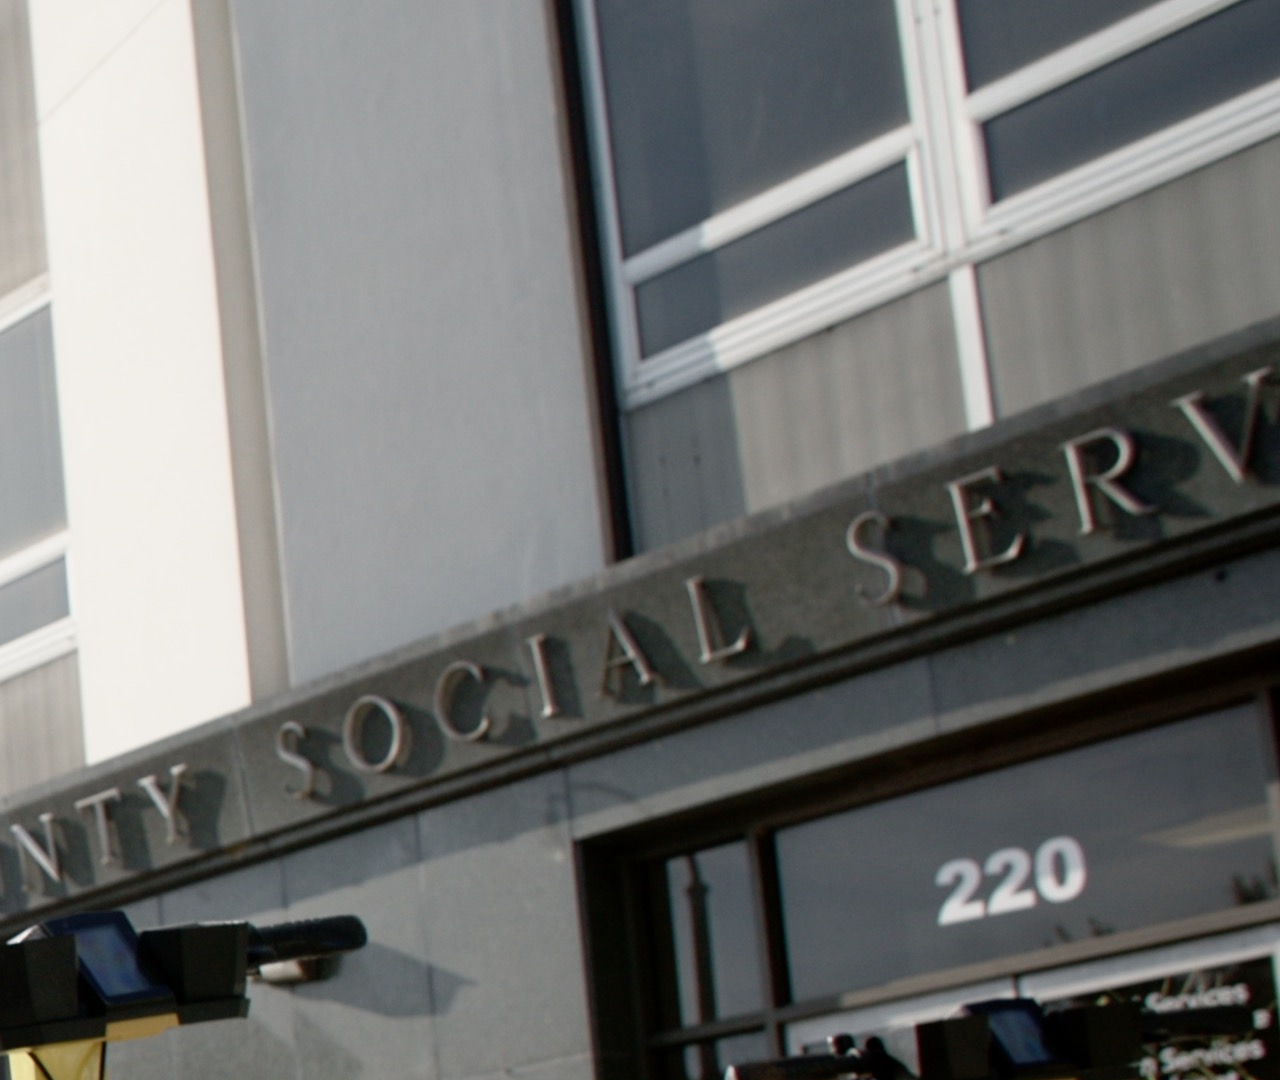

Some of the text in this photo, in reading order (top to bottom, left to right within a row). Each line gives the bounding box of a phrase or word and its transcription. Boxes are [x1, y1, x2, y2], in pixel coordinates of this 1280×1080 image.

[275, 574, 750, 801] SOCIAL
[844, 365, 1273, 606] SERV
[935, 836, 1086, 926] 220
